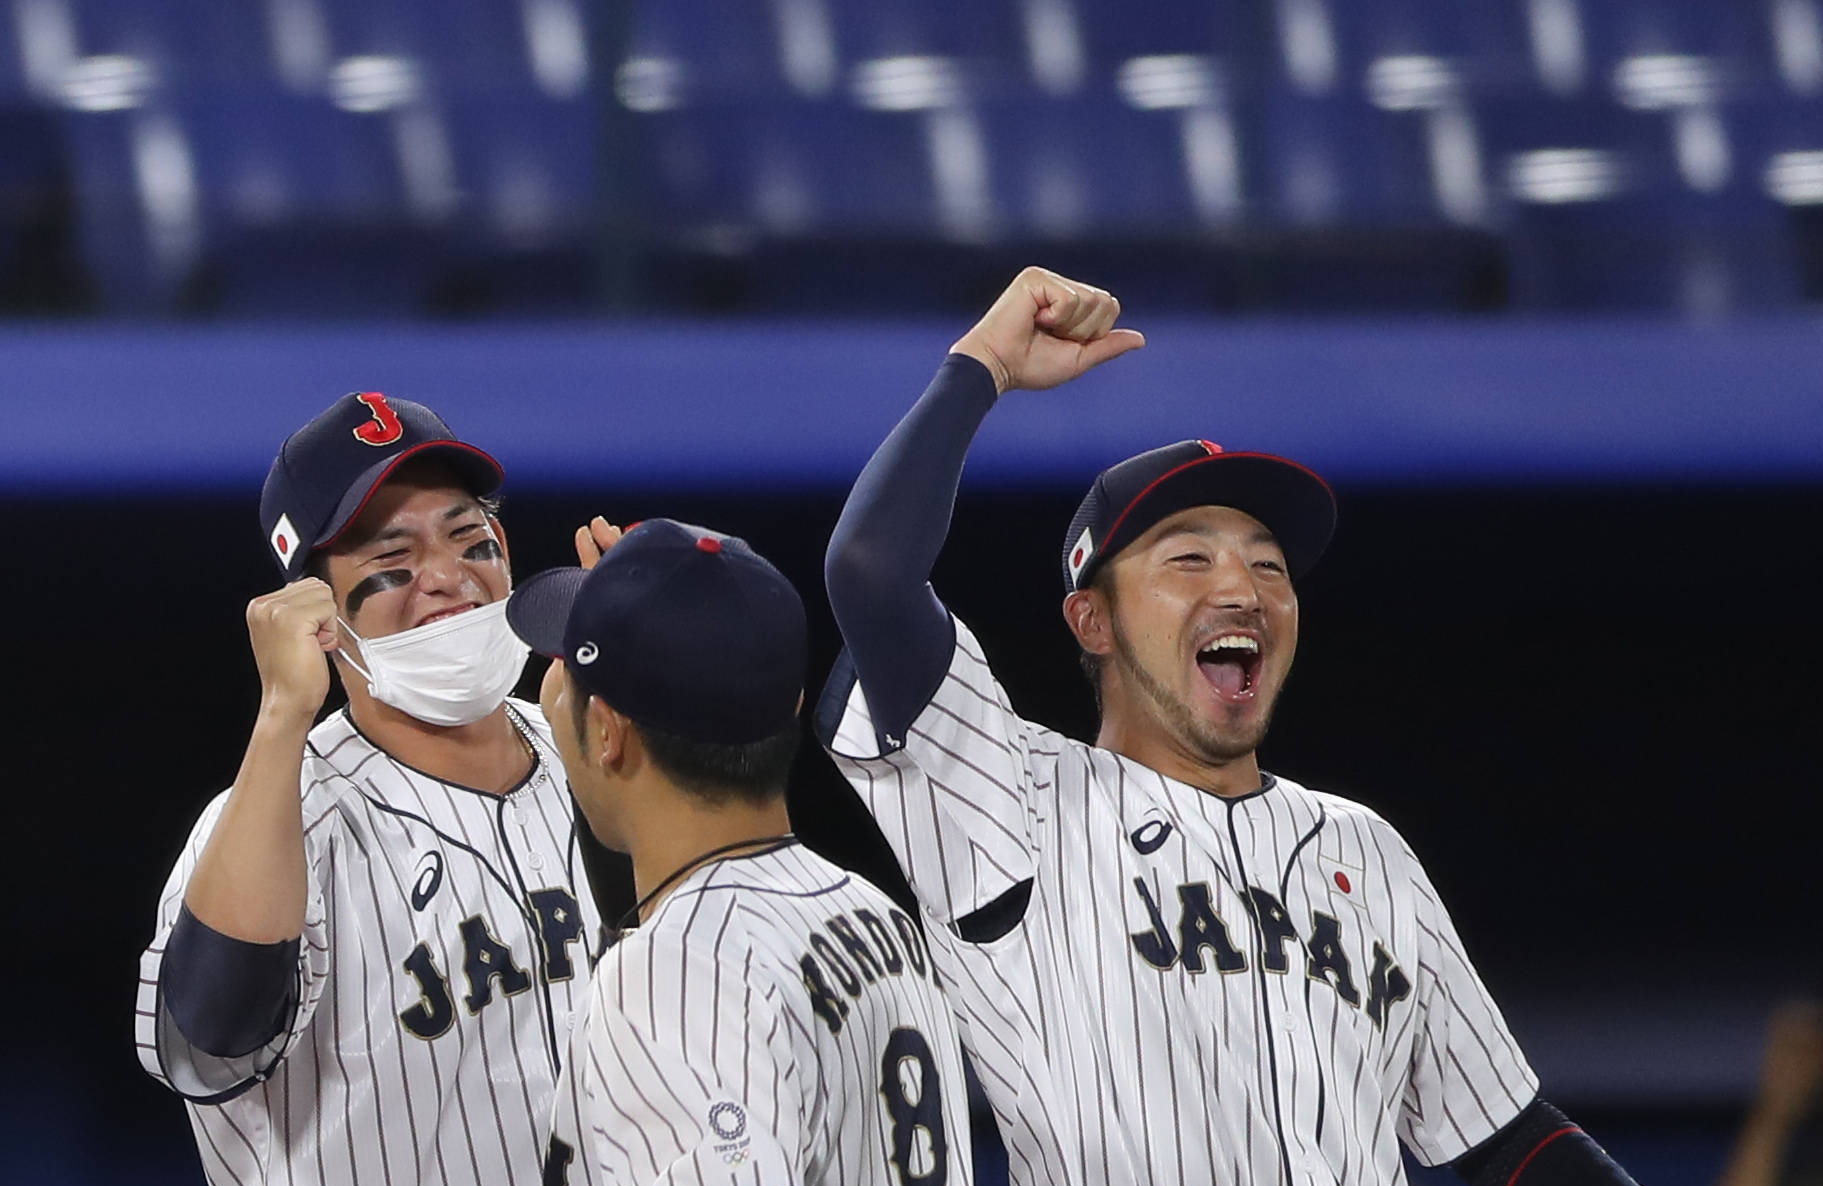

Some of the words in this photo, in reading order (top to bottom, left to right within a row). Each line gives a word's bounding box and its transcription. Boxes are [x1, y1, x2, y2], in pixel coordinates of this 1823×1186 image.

[352, 391, 403, 446] J
[399, 885, 612, 1041] JAP
[798, 907, 946, 1037] KONDO
[1130, 876, 1412, 1033] JAPAN
